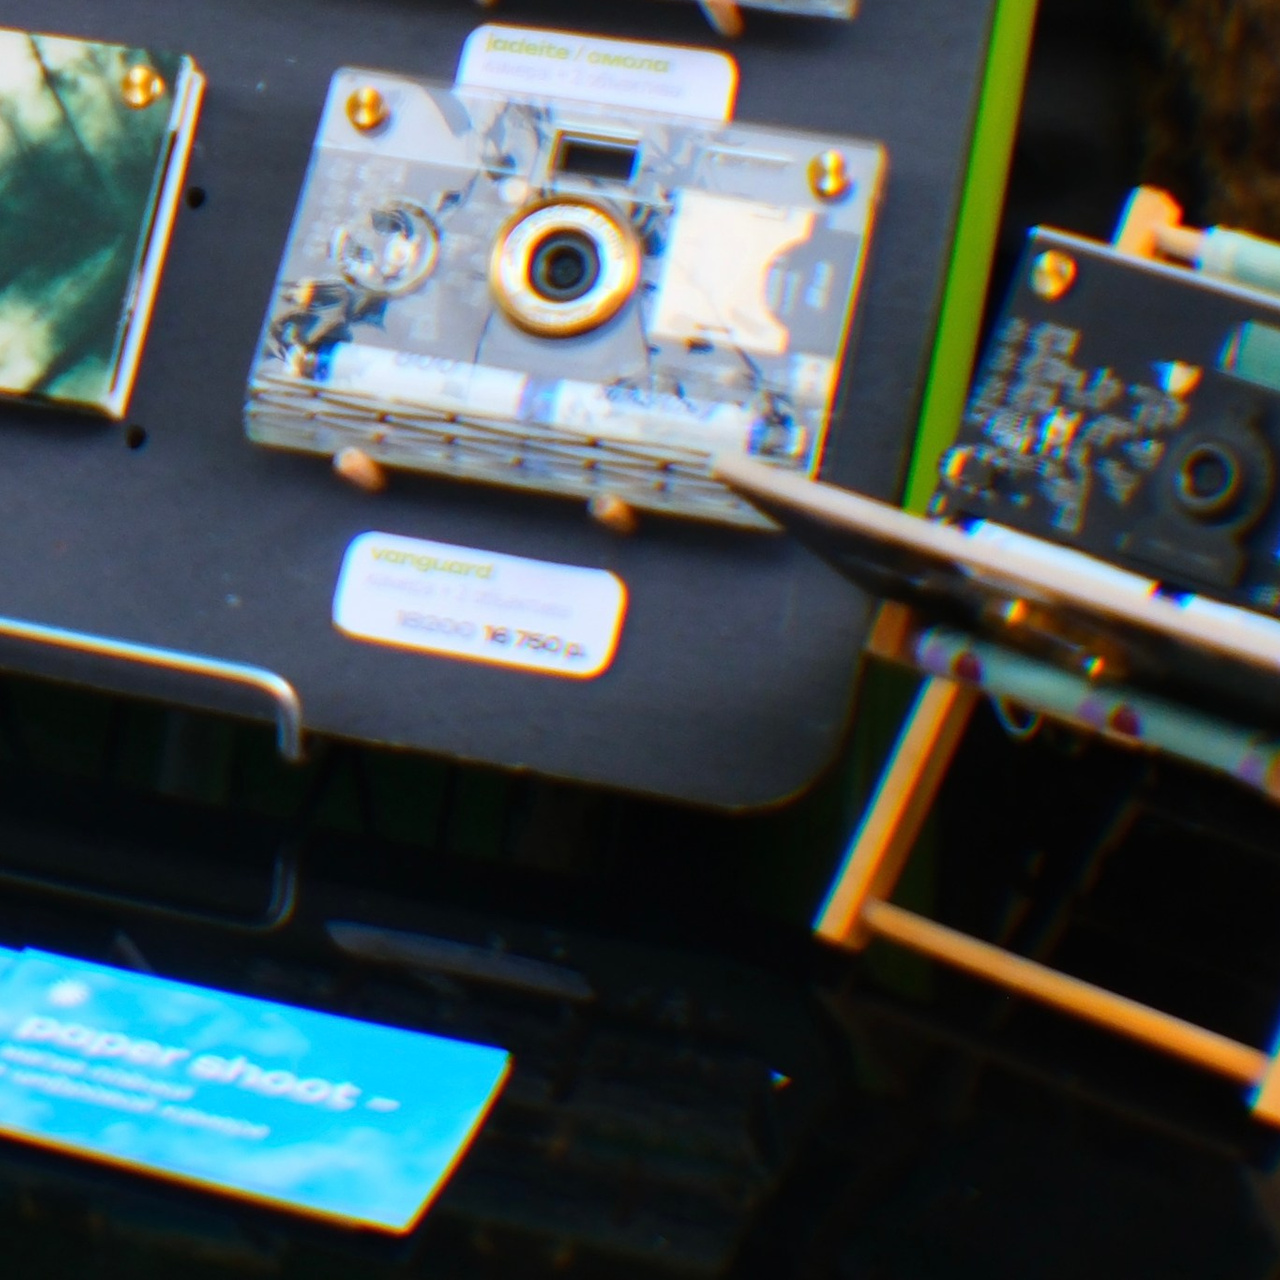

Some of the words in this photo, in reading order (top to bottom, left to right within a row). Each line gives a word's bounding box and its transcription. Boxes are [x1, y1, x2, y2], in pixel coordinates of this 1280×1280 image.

[370, 546, 495, 580] vanguard
[12, 1016, 192, 1068] paper
[187, 1053, 363, 1113] shoot
